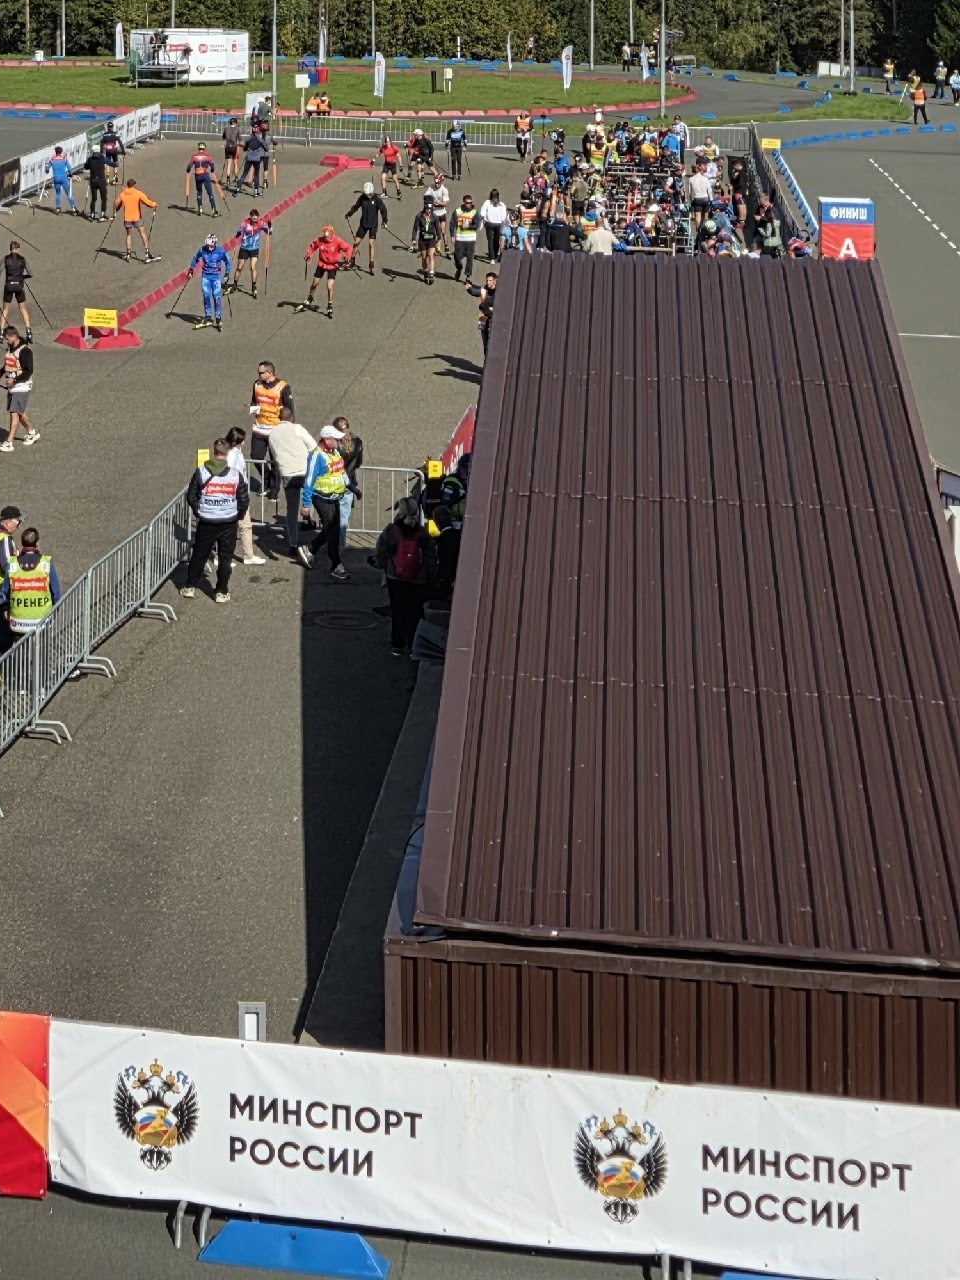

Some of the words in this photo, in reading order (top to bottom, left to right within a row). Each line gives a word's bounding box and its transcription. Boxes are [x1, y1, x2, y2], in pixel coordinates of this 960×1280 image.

[830, 206, 868, 220] ФИНИШ
[11, 596, 50, 608] ТРЕНЕР
[229, 1092, 423, 1139] МИНСПОРТ
[229, 1135, 374, 1178] РОССИИ
[701, 1143, 913, 1192] МИНСПОРТ
[701, 1187, 860, 1232] РОССИИ
